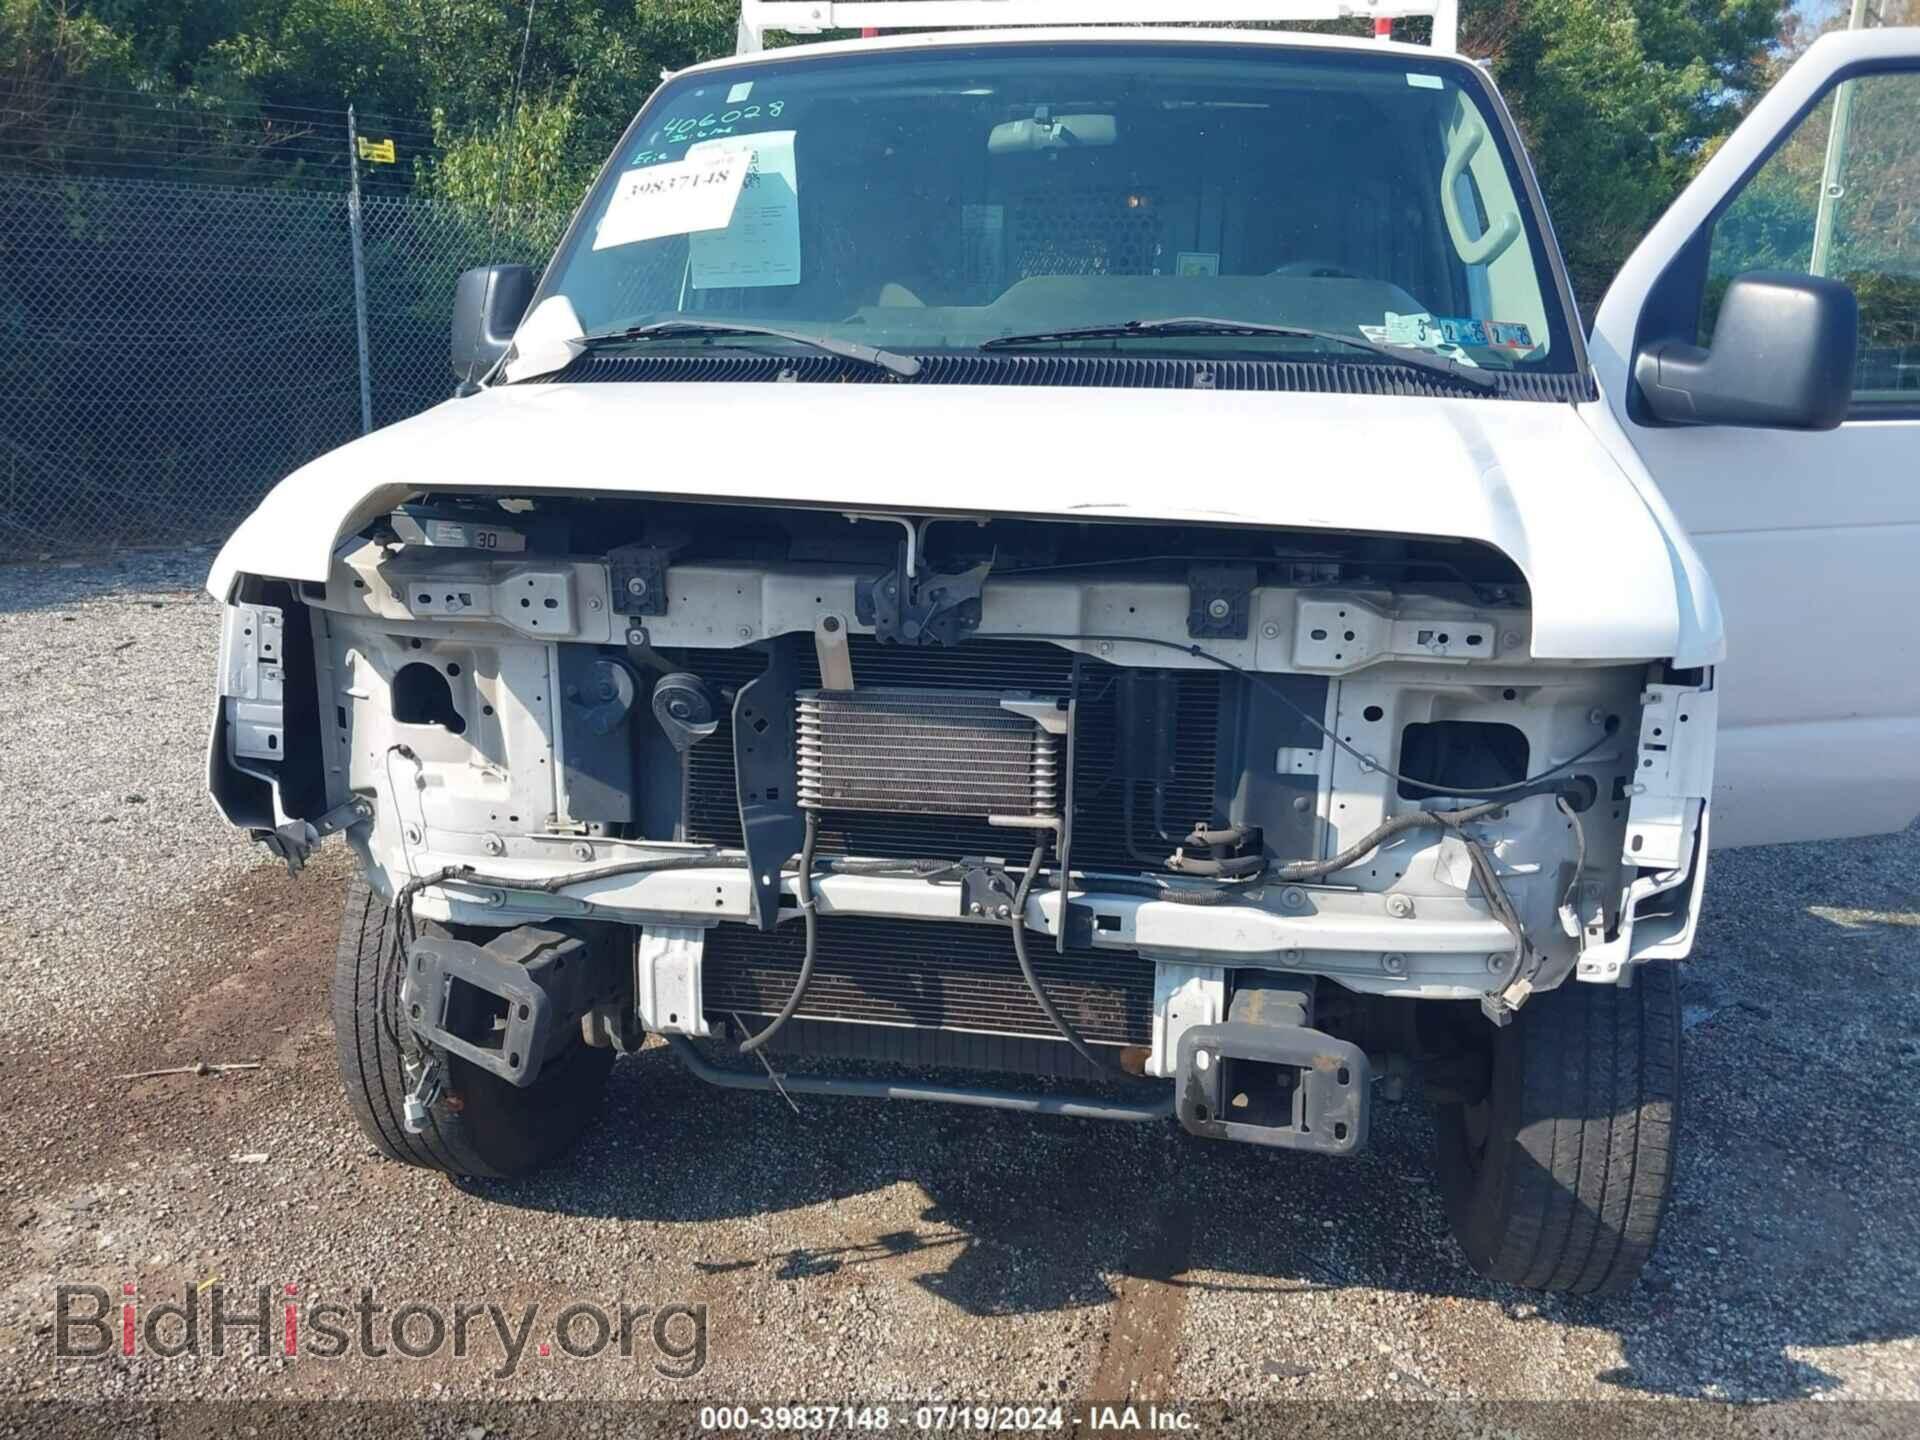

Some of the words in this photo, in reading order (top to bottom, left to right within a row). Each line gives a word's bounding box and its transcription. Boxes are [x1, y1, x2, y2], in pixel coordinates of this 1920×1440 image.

[663, 100, 785, 137] 406028
[625, 169, 730, 200] 39837148
[477, 532, 497, 548] 30
